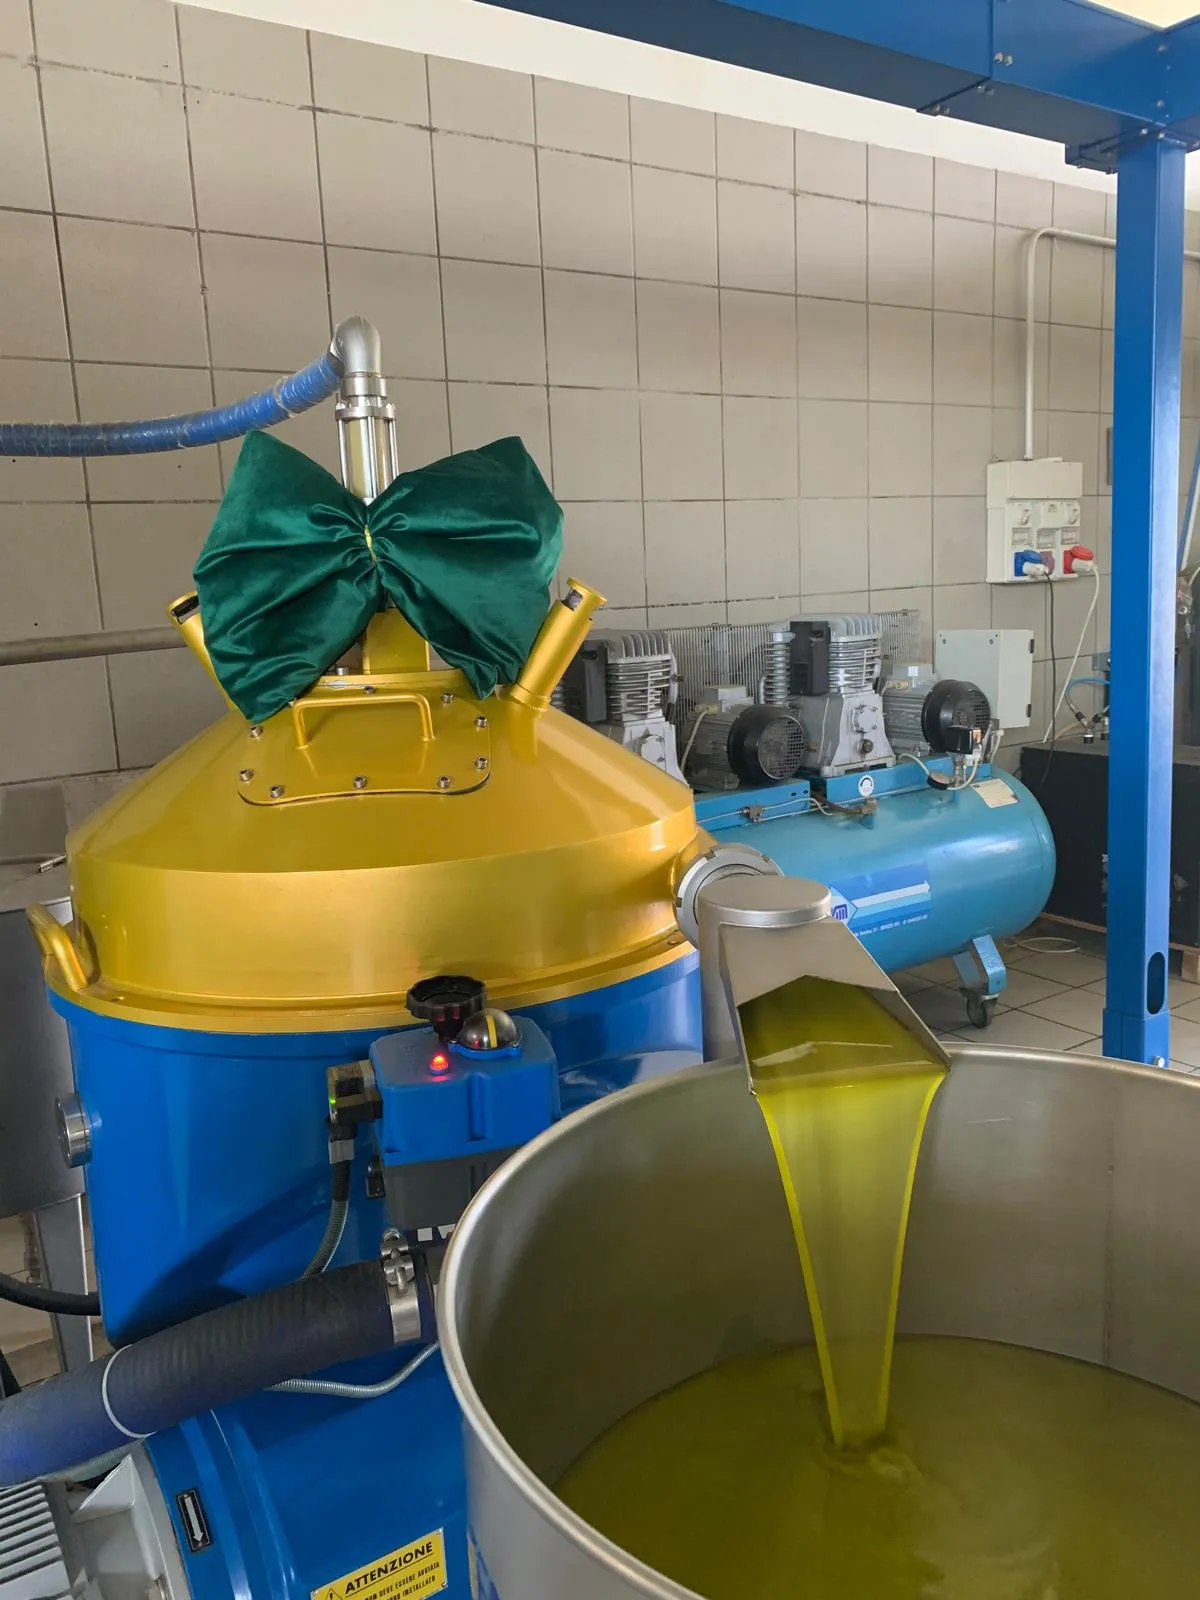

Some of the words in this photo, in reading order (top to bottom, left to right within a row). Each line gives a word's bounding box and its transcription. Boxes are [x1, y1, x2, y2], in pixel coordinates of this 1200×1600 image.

[345, 1541, 433, 1595] ATTENZIONE
[379, 1584, 393, 1598] DEVE
[395, 1573, 416, 1589] ESSERE
[417, 1561, 440, 1578] AVVIATA
[402, 1575, 436, 1596] INSTALLATO
